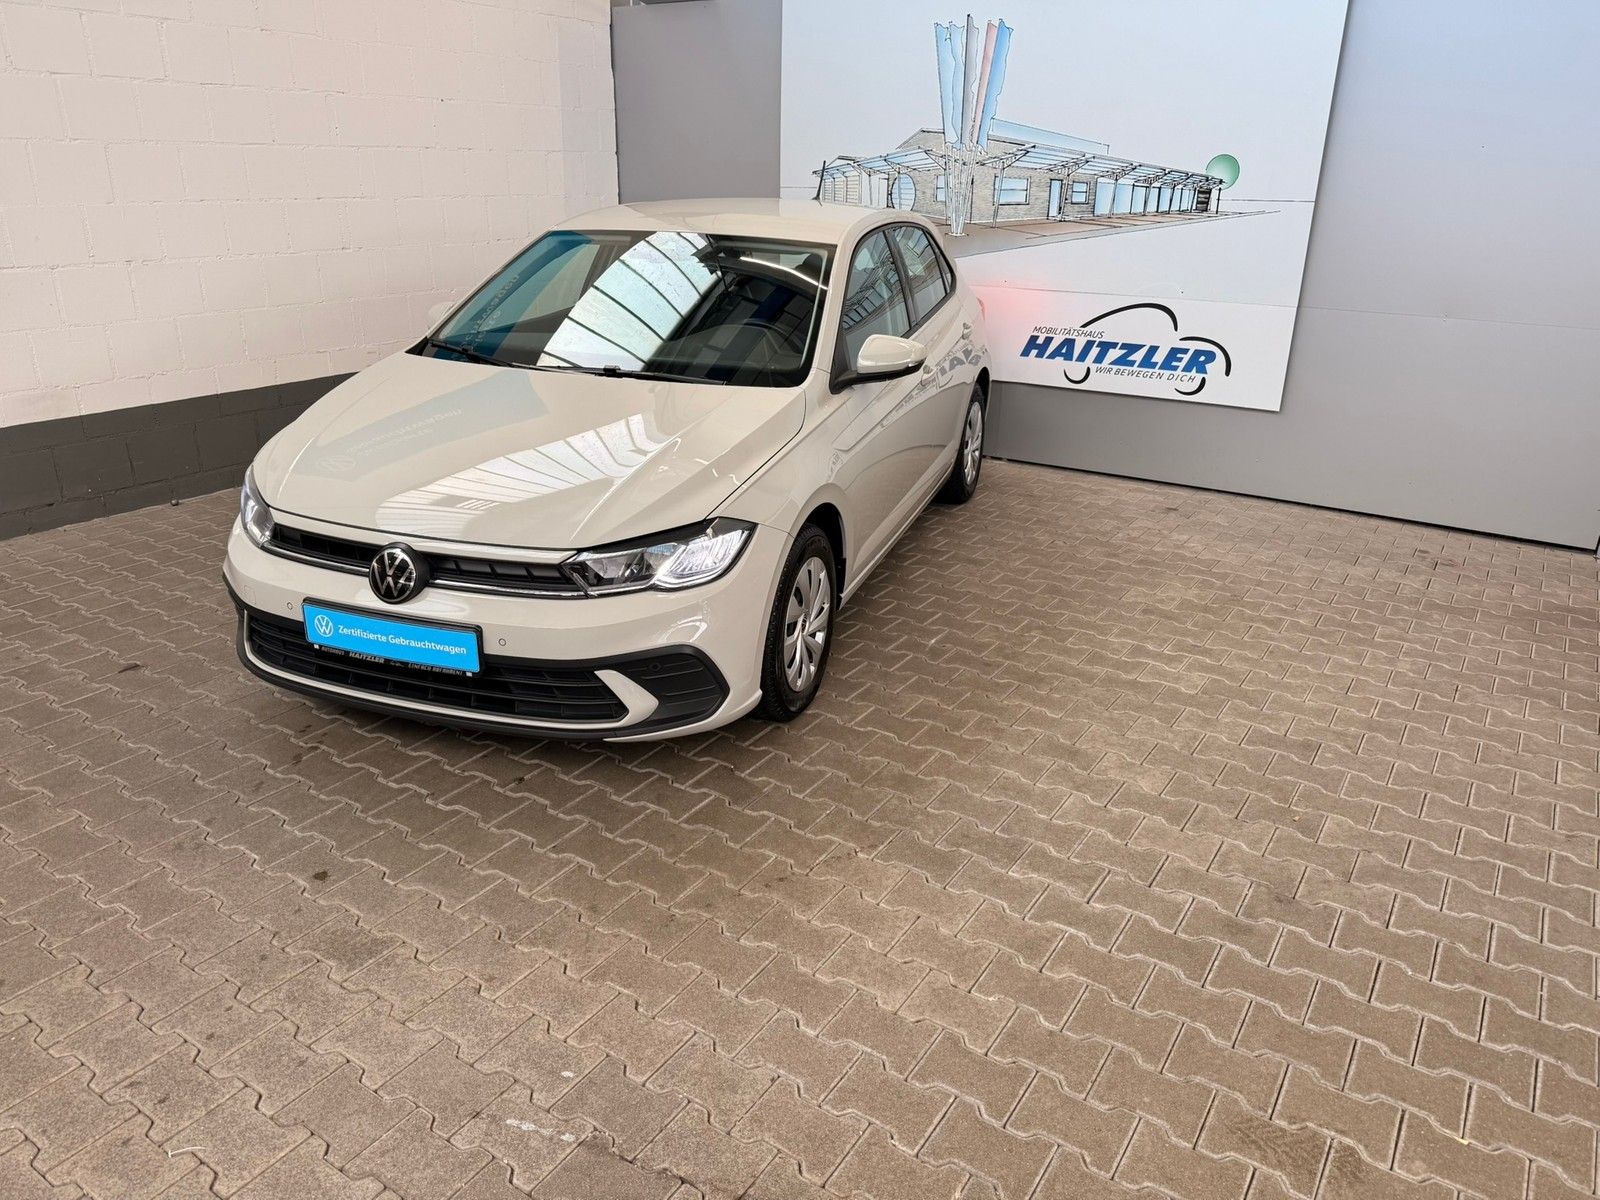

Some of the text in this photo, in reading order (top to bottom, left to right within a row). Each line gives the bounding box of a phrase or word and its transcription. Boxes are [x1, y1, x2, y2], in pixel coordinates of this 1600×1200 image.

[1032, 325, 1105, 339] MOBILITÄTSHAUS
[1020, 334, 1217, 375] HAITZLER
[1095, 366, 1197, 383] WIR BEWEGEN DICH
[338, 625, 467, 655] Zertifizierte Gebrauchtwagen
[348, 651, 385, 664] HAITZLER
